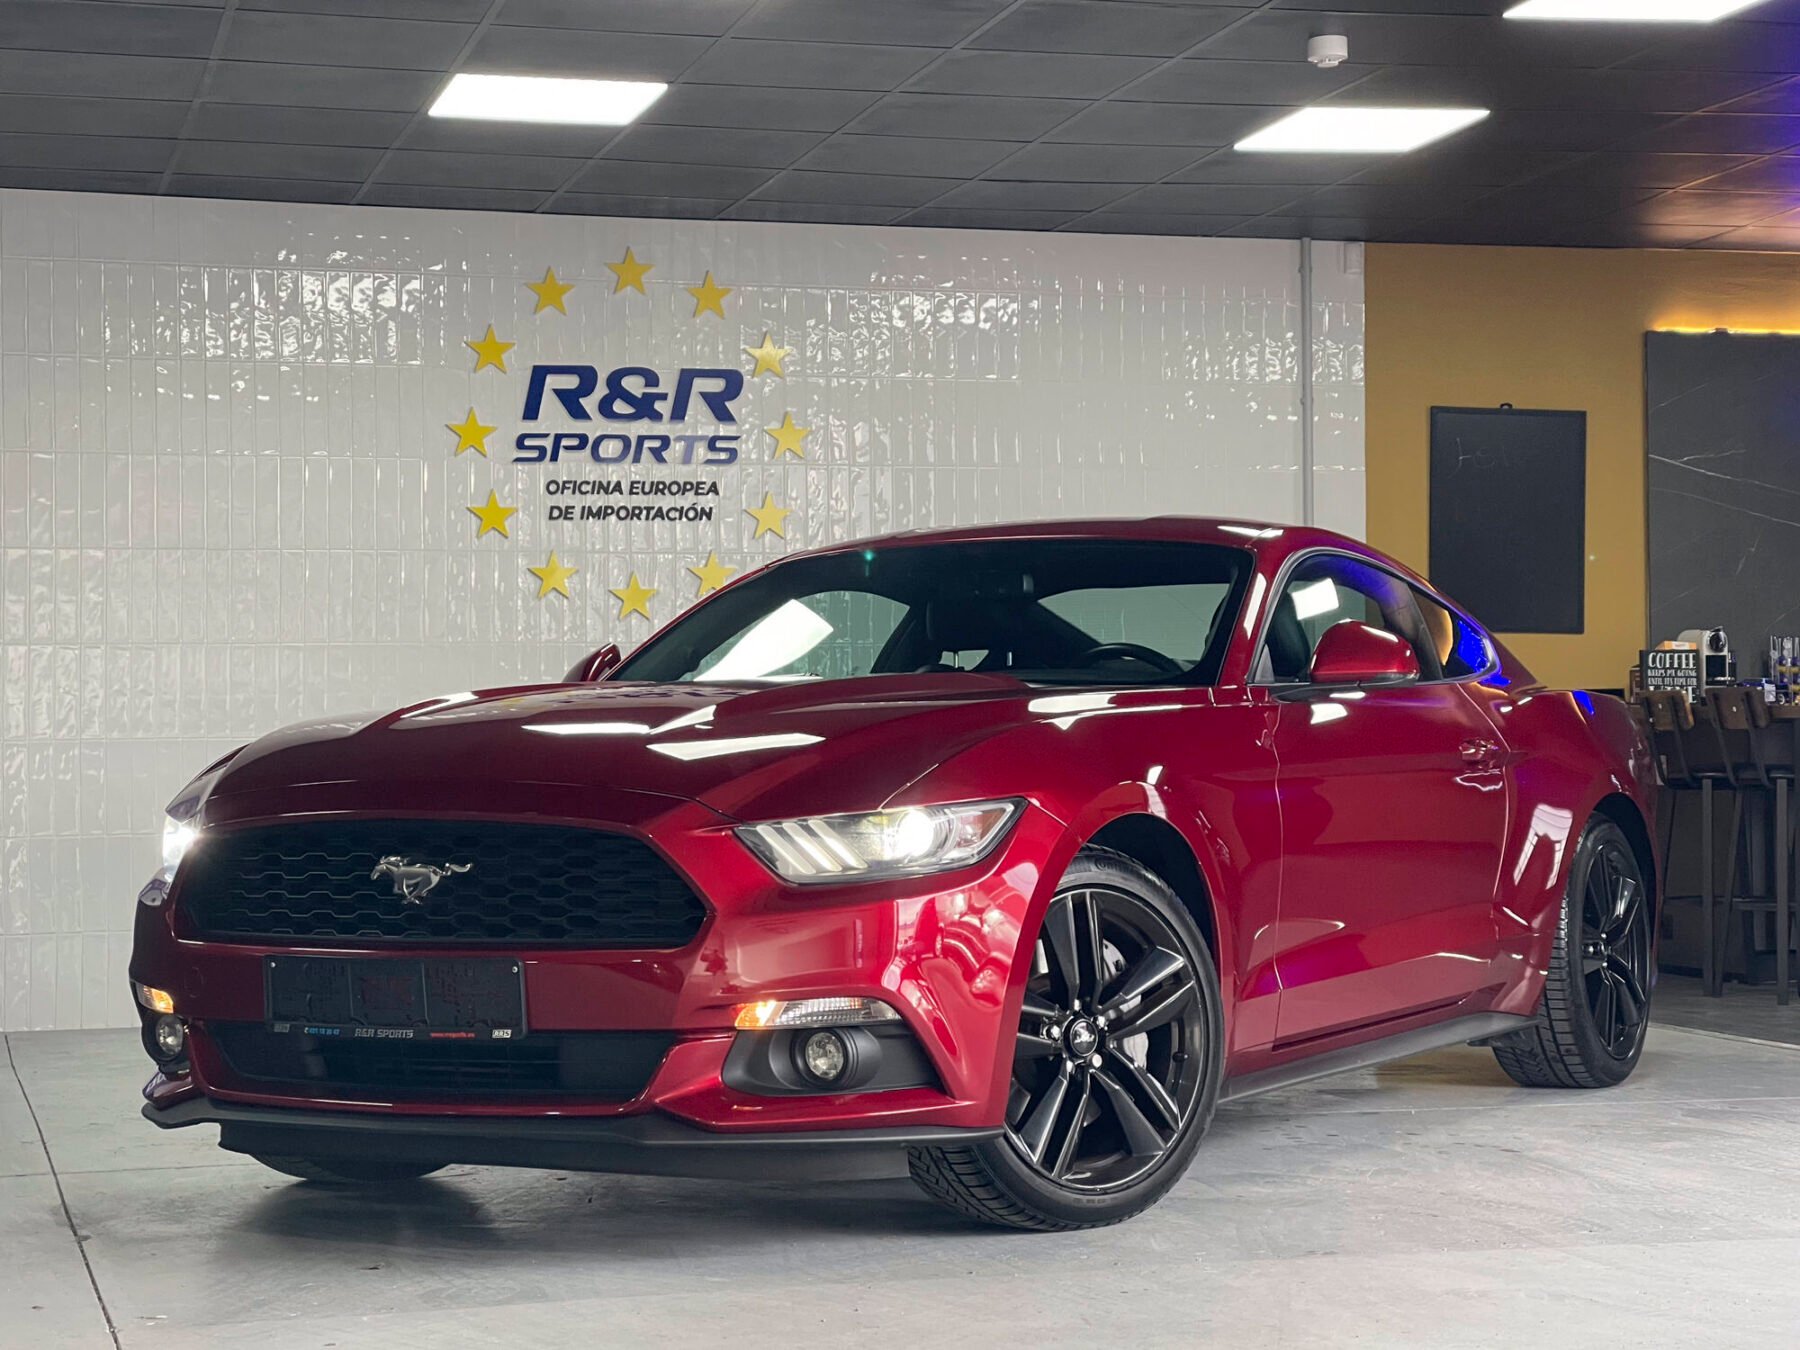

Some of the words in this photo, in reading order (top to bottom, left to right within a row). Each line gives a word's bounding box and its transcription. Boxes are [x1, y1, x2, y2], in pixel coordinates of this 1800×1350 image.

[522, 364, 744, 424] R&R
[512, 432, 742, 465] SPORTS
[545, 480, 624, 496] OFICINA
[628, 481, 719, 497] EUROPEA
[548, 506, 575, 521] DE
[579, 502, 713, 522] IMPORTACIÓN
[1648, 652, 1697, 669] COFFEE
[1677, 669, 1697, 677] GOING
[354, 1028, 375, 1038] R&R
[376, 1029, 414, 1039] SPORTS
